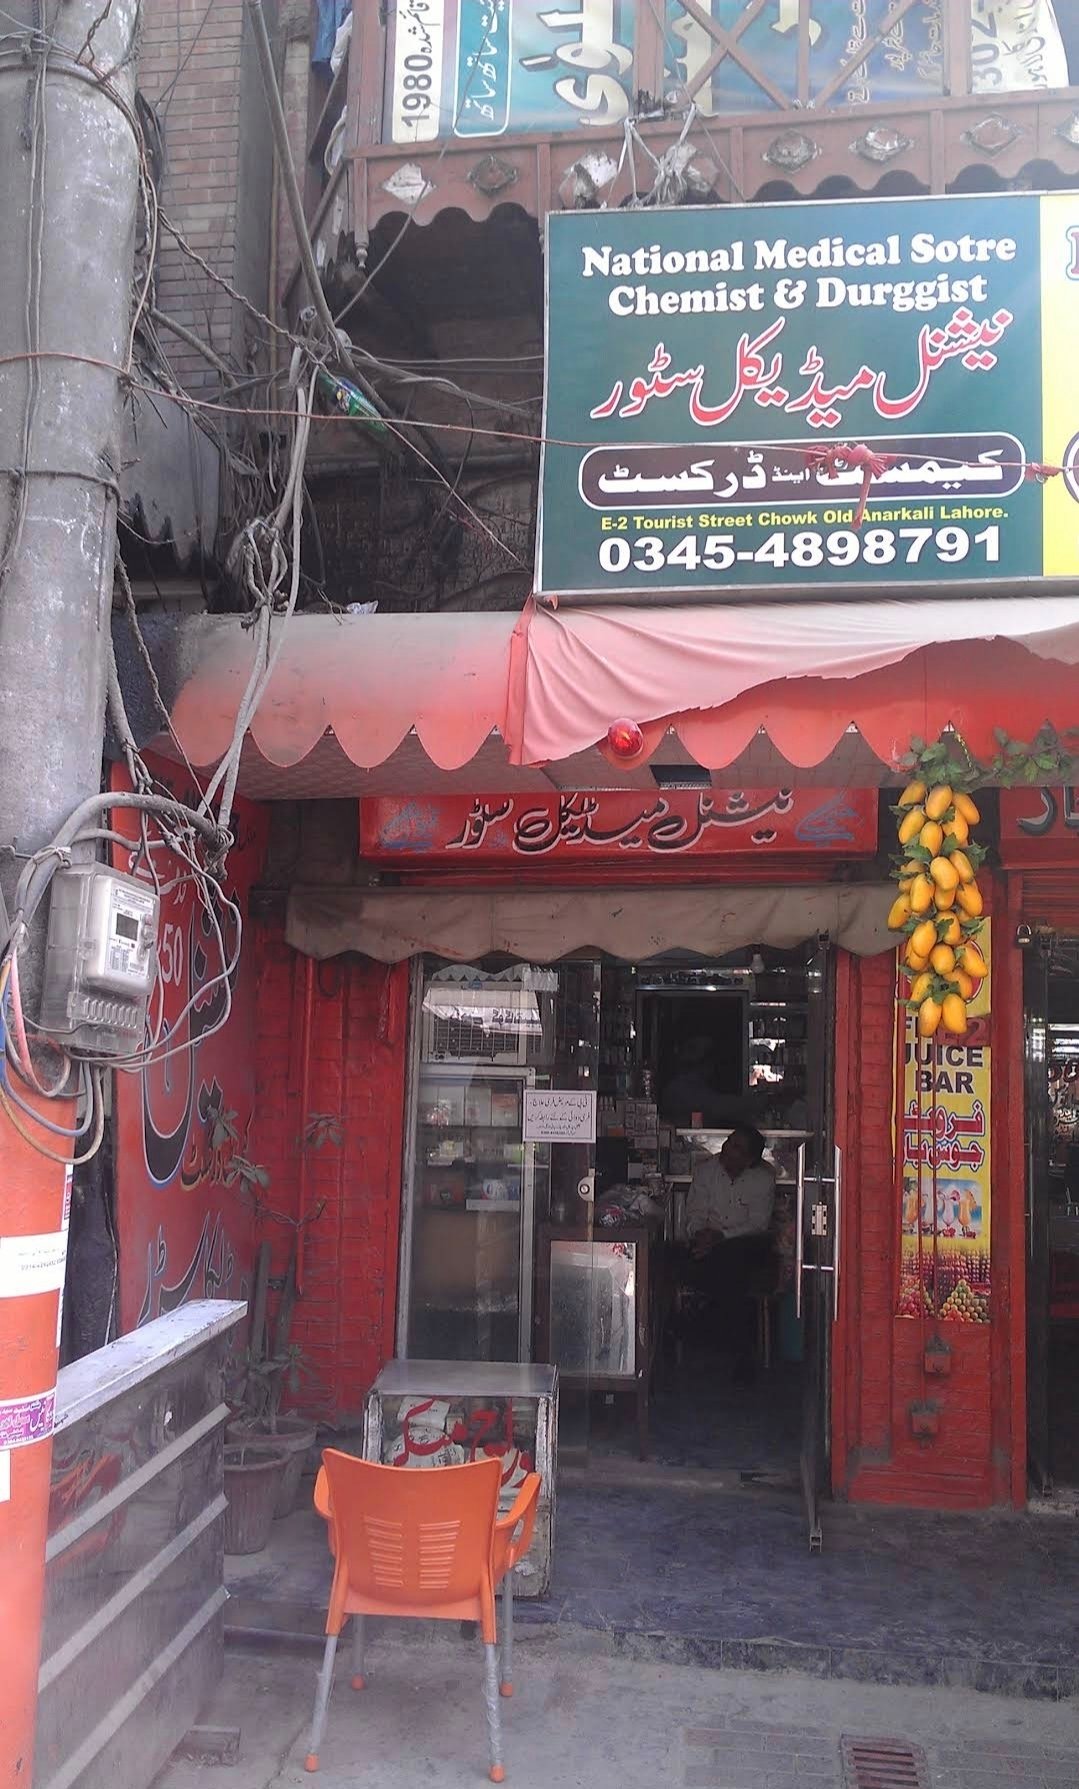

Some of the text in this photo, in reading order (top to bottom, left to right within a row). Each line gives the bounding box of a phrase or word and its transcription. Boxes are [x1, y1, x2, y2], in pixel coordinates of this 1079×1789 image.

[401, 54, 433, 127] 1980
[581, 232, 1017, 278] National Medical Sotre
[608, 273, 988, 316] Chemist & Durggist
[589, 342, 703, 419] سٹور
[872, 305, 1014, 420] نیشنل
[771, 460, 811, 483] اینڈ
[601, 504, 1009, 531] E-2 Tourist Street Chowk Old Anarkali Lahore.
[598, 525, 1001, 573] 0345-4898791
[904, 1043, 983, 1067] JUICE
[915, 1070, 974, 1094] BAR
